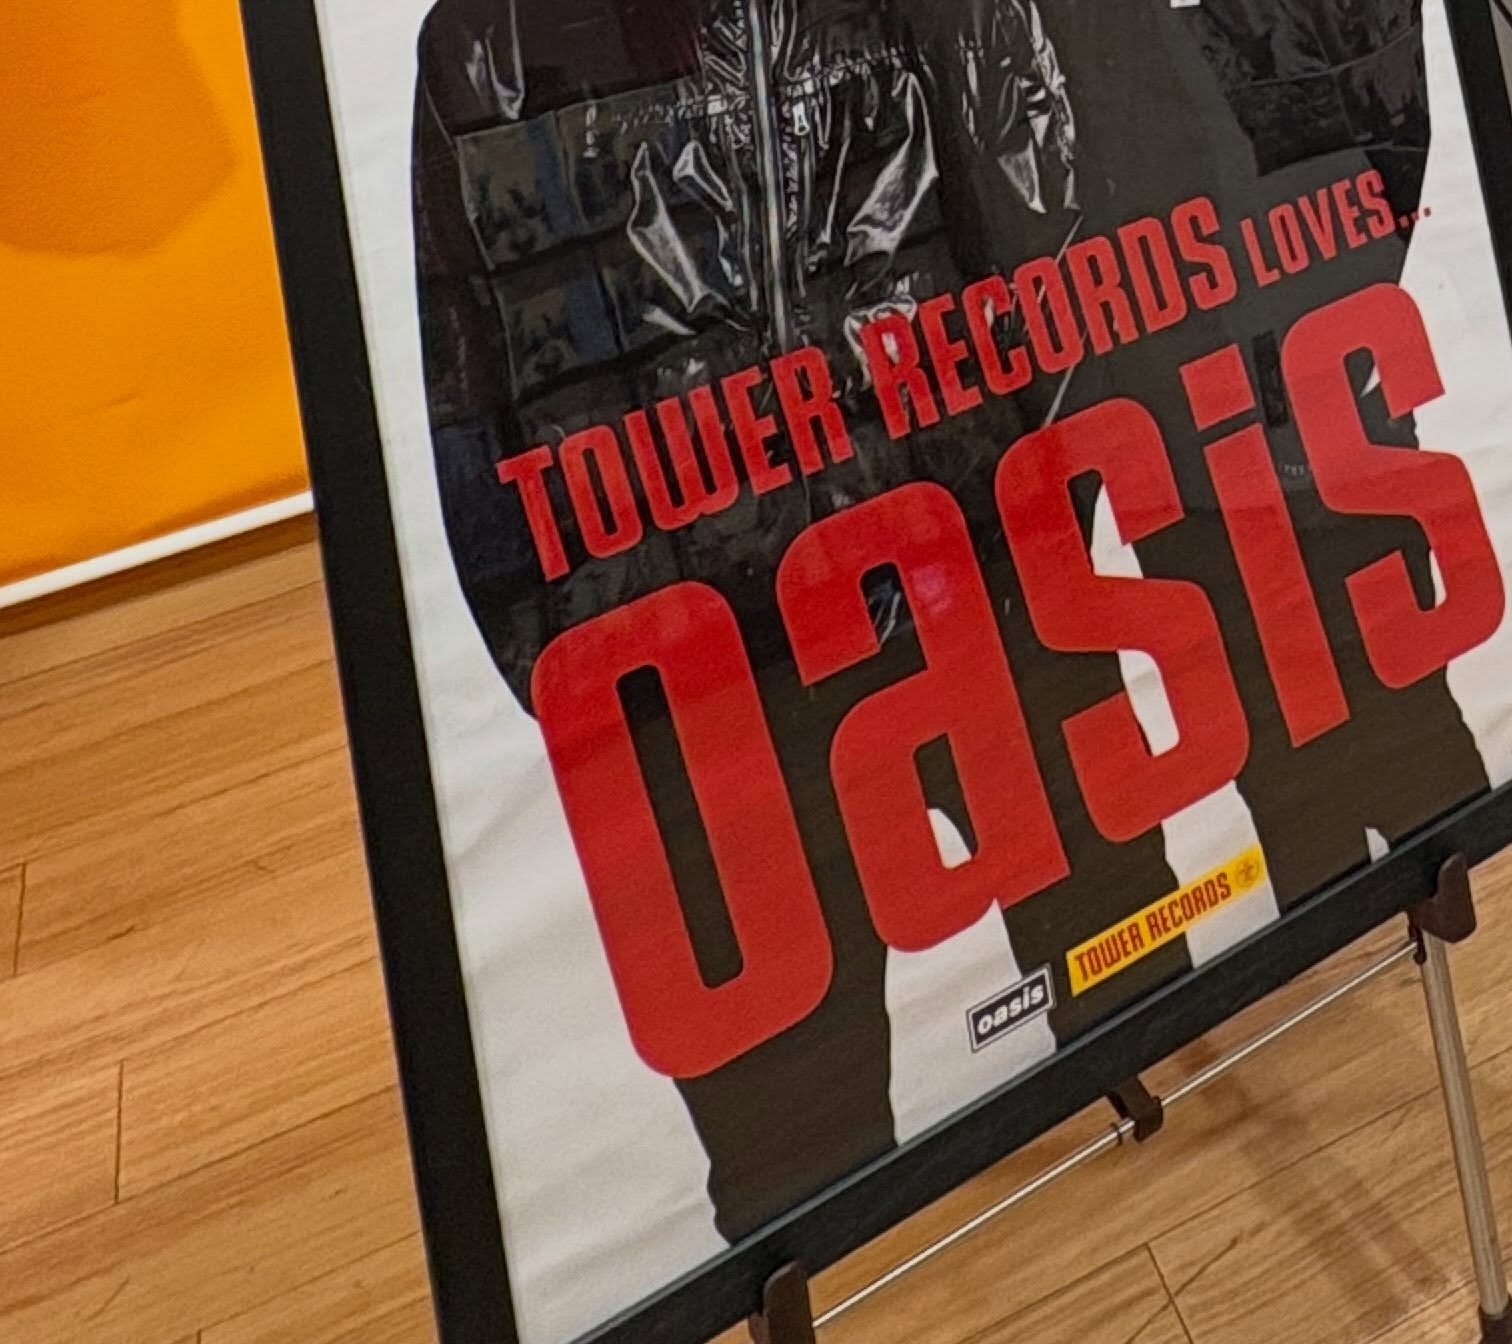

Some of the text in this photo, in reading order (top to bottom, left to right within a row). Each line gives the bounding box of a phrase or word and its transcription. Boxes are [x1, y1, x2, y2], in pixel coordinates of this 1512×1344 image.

[495, 344, 856, 583] TOWER
[855, 195, 1239, 441] RECORDS
[529, 281, 1506, 1081] oasis
[976, 981, 1045, 1036] oasis
[1074, 871, 1233, 983] TOWER RECORDS
